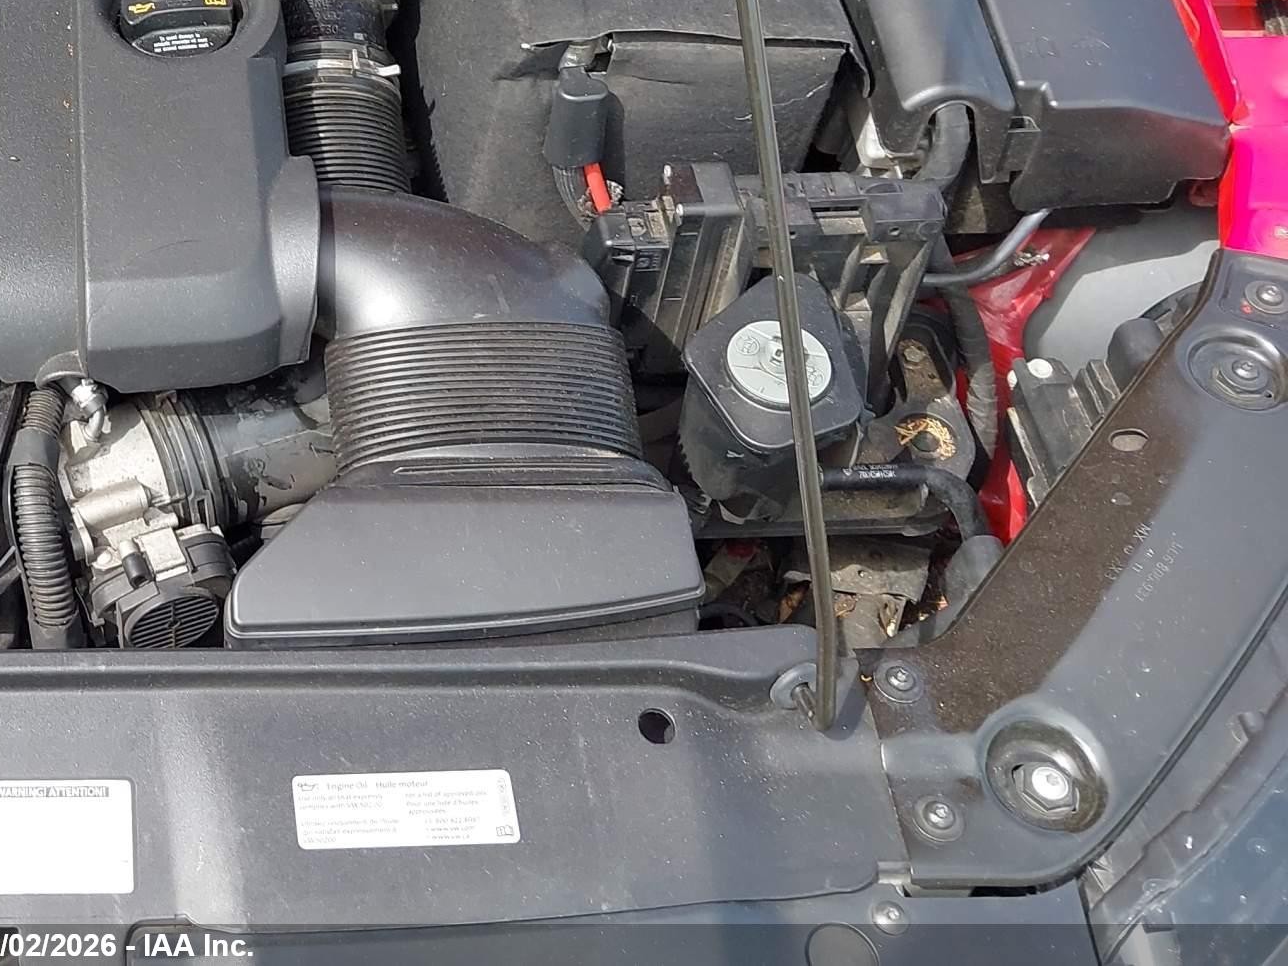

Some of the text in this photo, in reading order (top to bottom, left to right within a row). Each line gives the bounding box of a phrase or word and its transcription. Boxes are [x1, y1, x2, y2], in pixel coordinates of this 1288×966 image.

[48, 786, 106, 797] ATTENTION!
[326, 780, 354, 792] Engine
[375, 780, 397, 789] Huile
[398, 779, 429, 788] moteur
